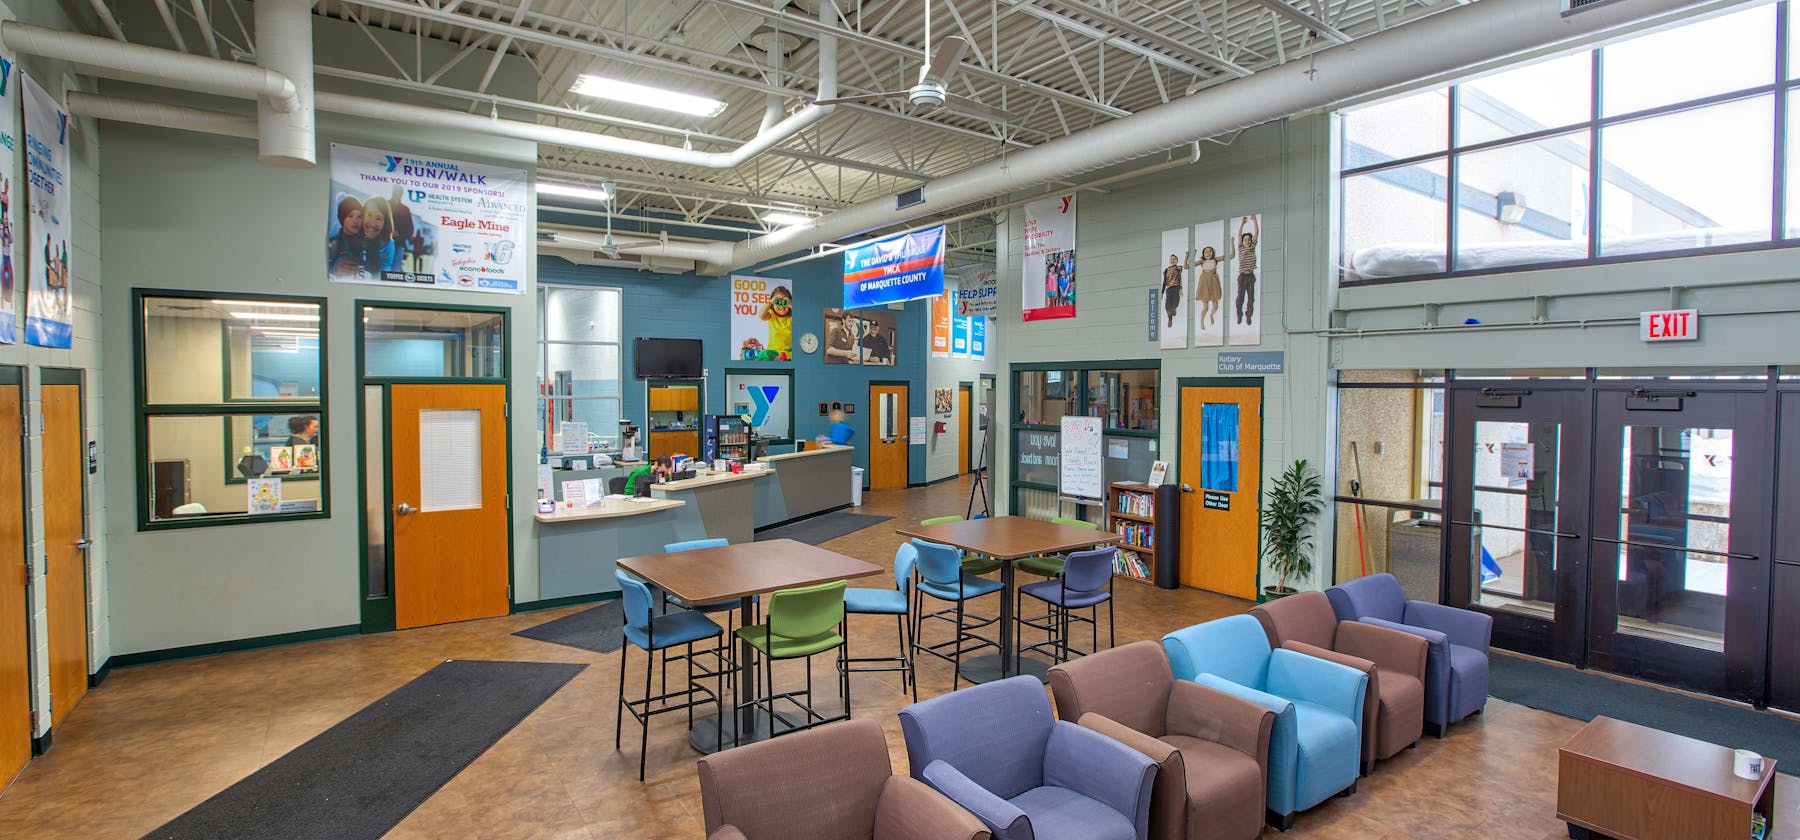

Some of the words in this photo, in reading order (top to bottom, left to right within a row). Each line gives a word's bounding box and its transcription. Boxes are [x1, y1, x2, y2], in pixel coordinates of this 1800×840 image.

[405, 158, 424, 167] 19th
[426, 161, 458, 171] ANNUAL
[403, 166, 486, 185] RUN/WALK
[360, 174, 388, 183] THANK
[391, 178, 408, 186] YOU
[423, 181, 439, 189] OUR
[442, 184, 462, 192] 2019
[464, 186, 504, 197] SPONSORS!
[408, 190, 426, 203] UP
[428, 194, 449, 202] HEALTH
[441, 216, 475, 230] Eagle
[478, 220, 509, 232] Mine
[860, 259, 871, 268] THE
[872, 256, 887, 265] DAVID
[883, 265, 900, 275] YMCA
[734, 280, 766, 291] GOOD
[860, 284, 867, 292] OF
[868, 277, 901, 290] MARQUETTE
[902, 272, 926, 283] COUNTY
[734, 292, 749, 302] TO
[752, 293, 770, 304] SEE
[960, 290, 977, 299] HELP
[734, 304, 757, 316] YOU
[1650, 313, 1690, 337] EXIT
[1244, 363, 1280, 371] Marquette
